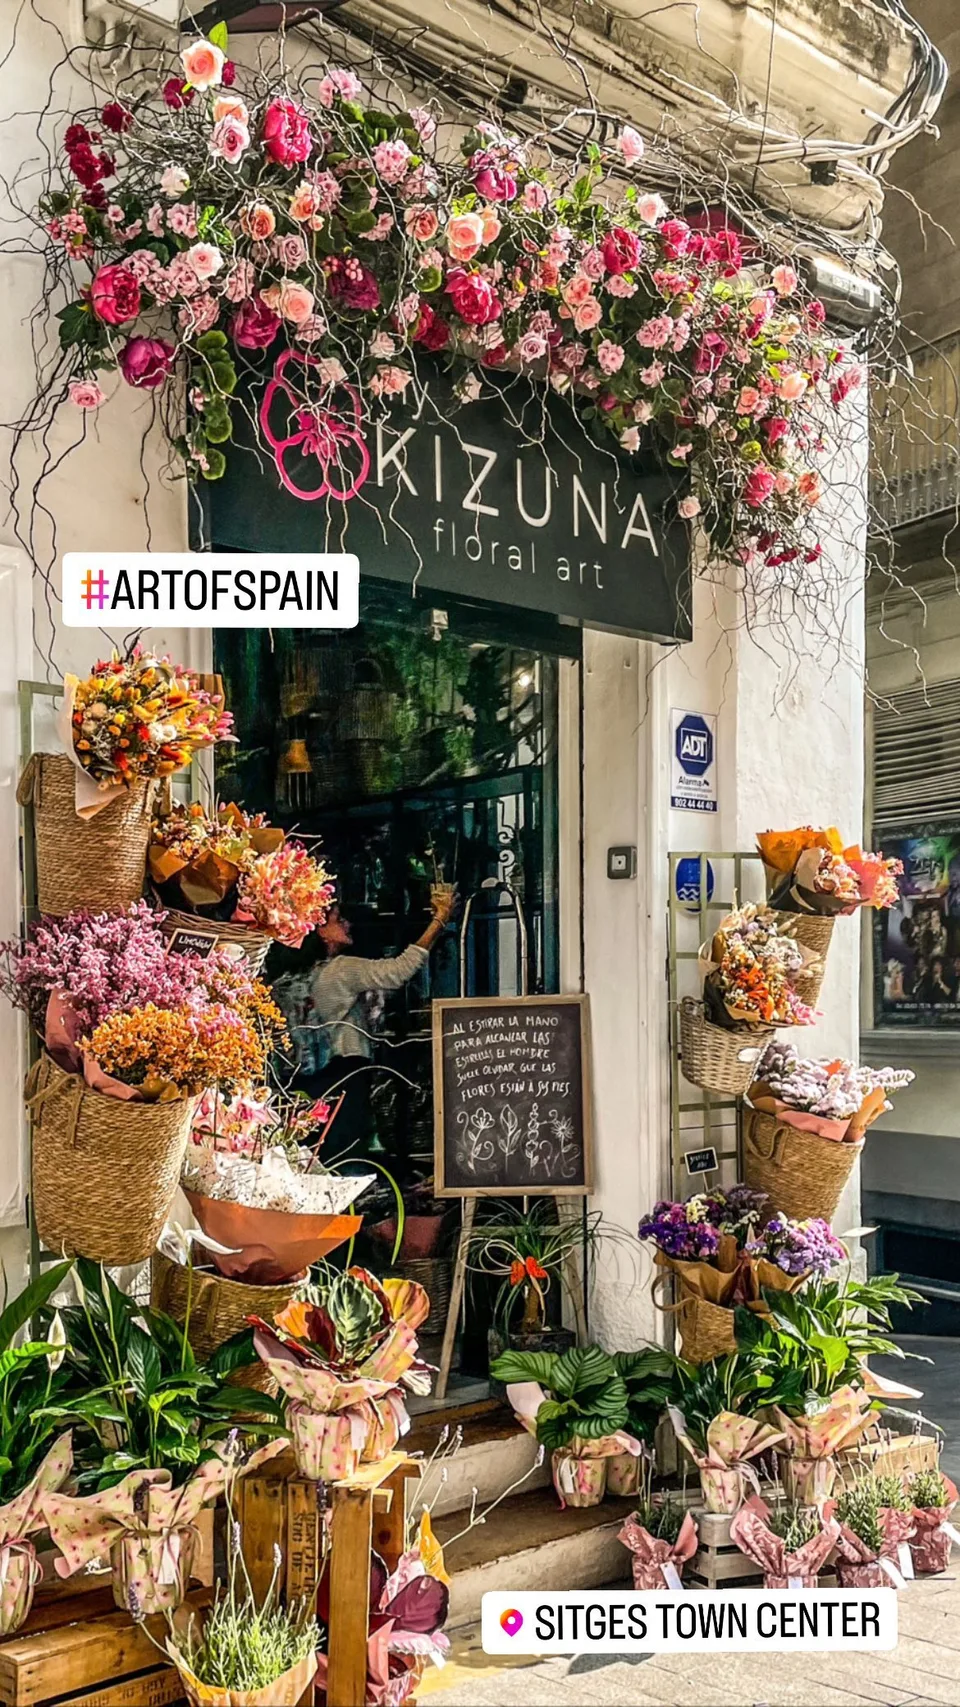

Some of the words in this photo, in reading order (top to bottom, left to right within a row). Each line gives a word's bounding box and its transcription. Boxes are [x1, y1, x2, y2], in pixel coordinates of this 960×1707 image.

[377, 419, 659, 557] KIZUNA
[433, 518, 536, 574] floral
[557, 556, 604, 589] art
[682, 735, 707, 758] ADT
[678, 776, 702, 787] Alarma
[675, 798, 687, 808] 902
[687, 799, 695, 809] 44
[697, 800, 705, 809] 44
[453, 1023, 466, 1034] AL
[469, 1017, 504, 1034] ESTIRAR
[509, 1016, 519, 1026] LA
[526, 1016, 559, 1026] MANO
[454, 1037, 482, 1051] PARA
[533, 1032, 551, 1045] LAS
[497, 1049, 506, 1059] EL
[510, 1048, 550, 1059] HOMBRE
[541, 1063, 556, 1075] LAS
[461, 1083, 496, 1102] FLORES
